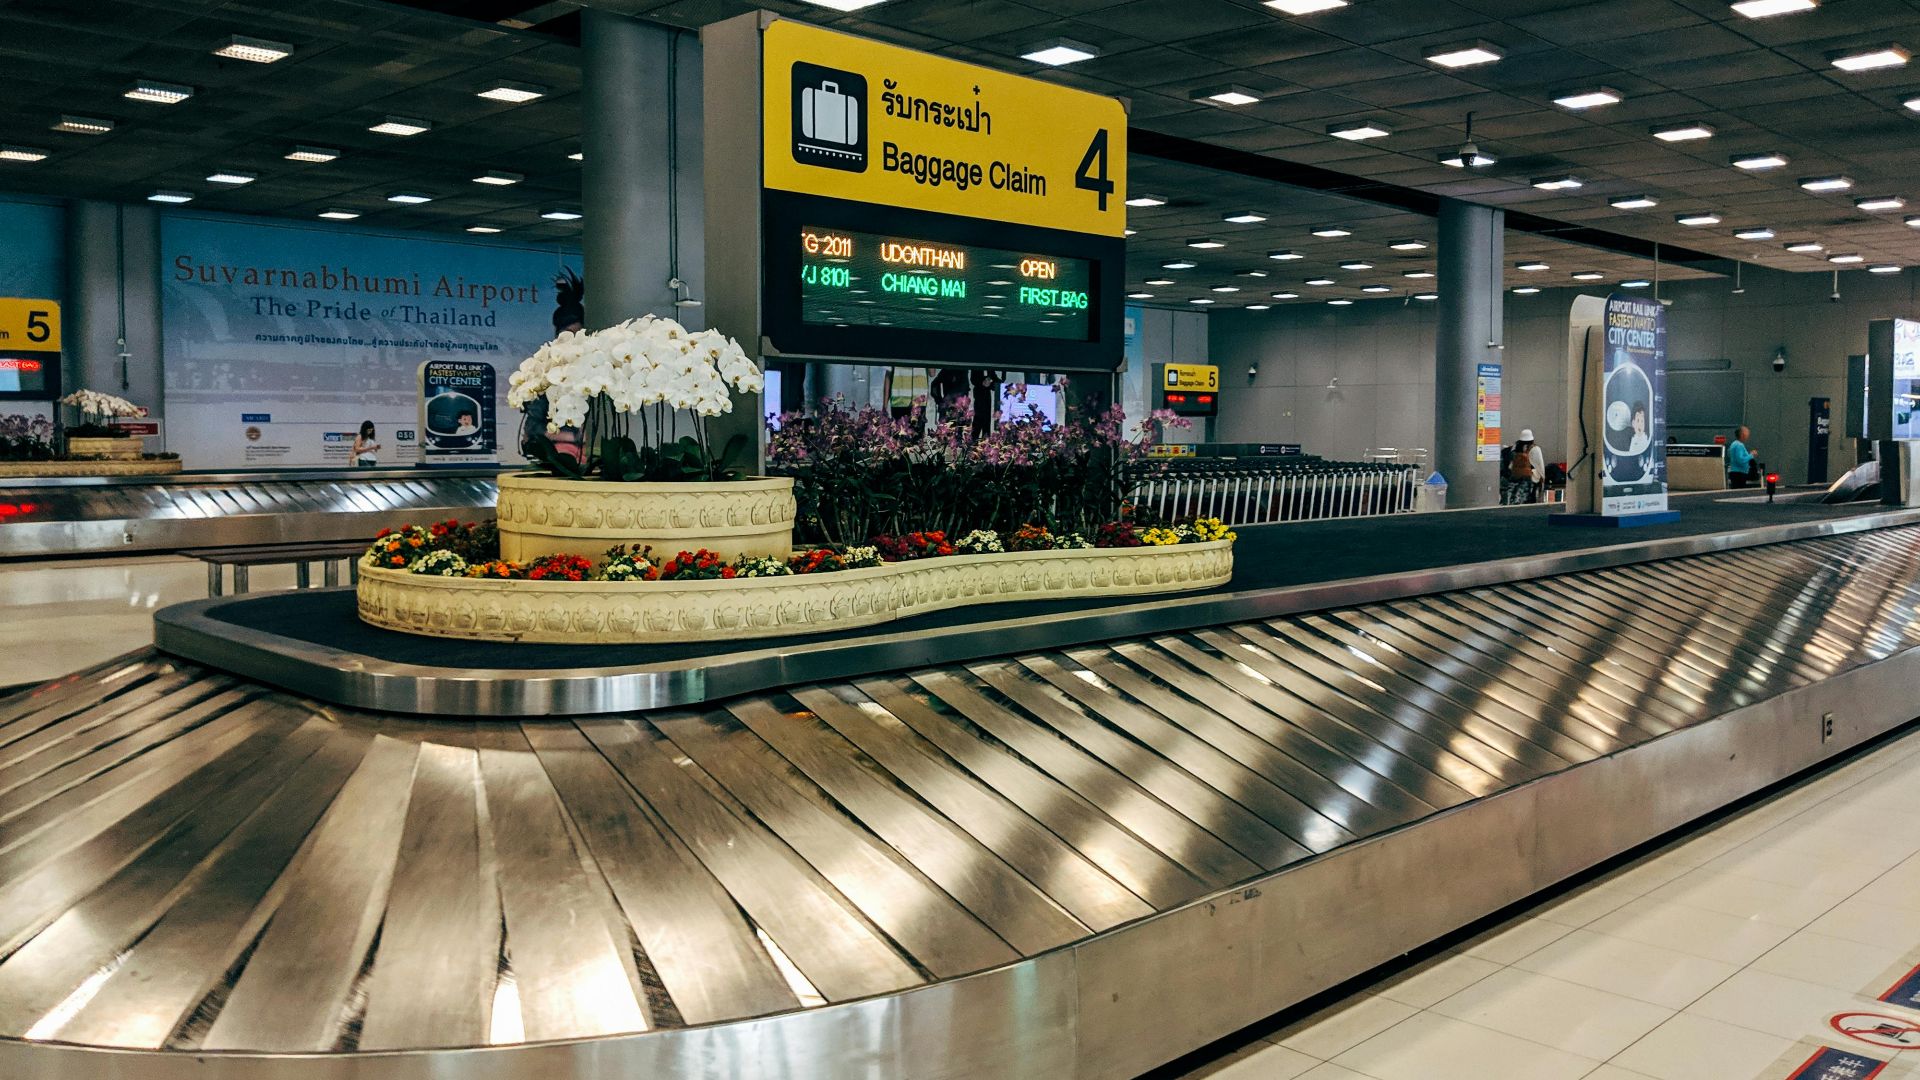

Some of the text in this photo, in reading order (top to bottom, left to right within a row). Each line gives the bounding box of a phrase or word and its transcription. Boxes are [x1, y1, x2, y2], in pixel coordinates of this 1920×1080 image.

[881, 78, 991, 135] รับกระเป๋า
[882, 141, 1047, 197] Baggage Claim
[1075, 128, 1114, 212] 4
[801, 233, 1055, 279] G 2011 UDONTHANI OPEN
[174, 254, 539, 308] Suvarnabhumi Airport
[820, 267, 849, 287] 8101
[881, 273, 938, 296] CHIANG
[941, 278, 966, 298] MAI
[1020, 286, 1059, 306] FIRST
[1060, 290, 1088, 309] BAG
[250, 295, 497, 328] The Pride of Thailand
[1609, 300, 1632, 313] AIRPORT
[1609, 312, 1633, 328] FASTEST
[26, 311, 50, 342] 5
[1609, 327, 1656, 348] CITY CENTER
[429, 369, 456, 377] FASTEST
[429, 376, 481, 385] CITY CENTER
[1209, 371, 1215, 387] 5
